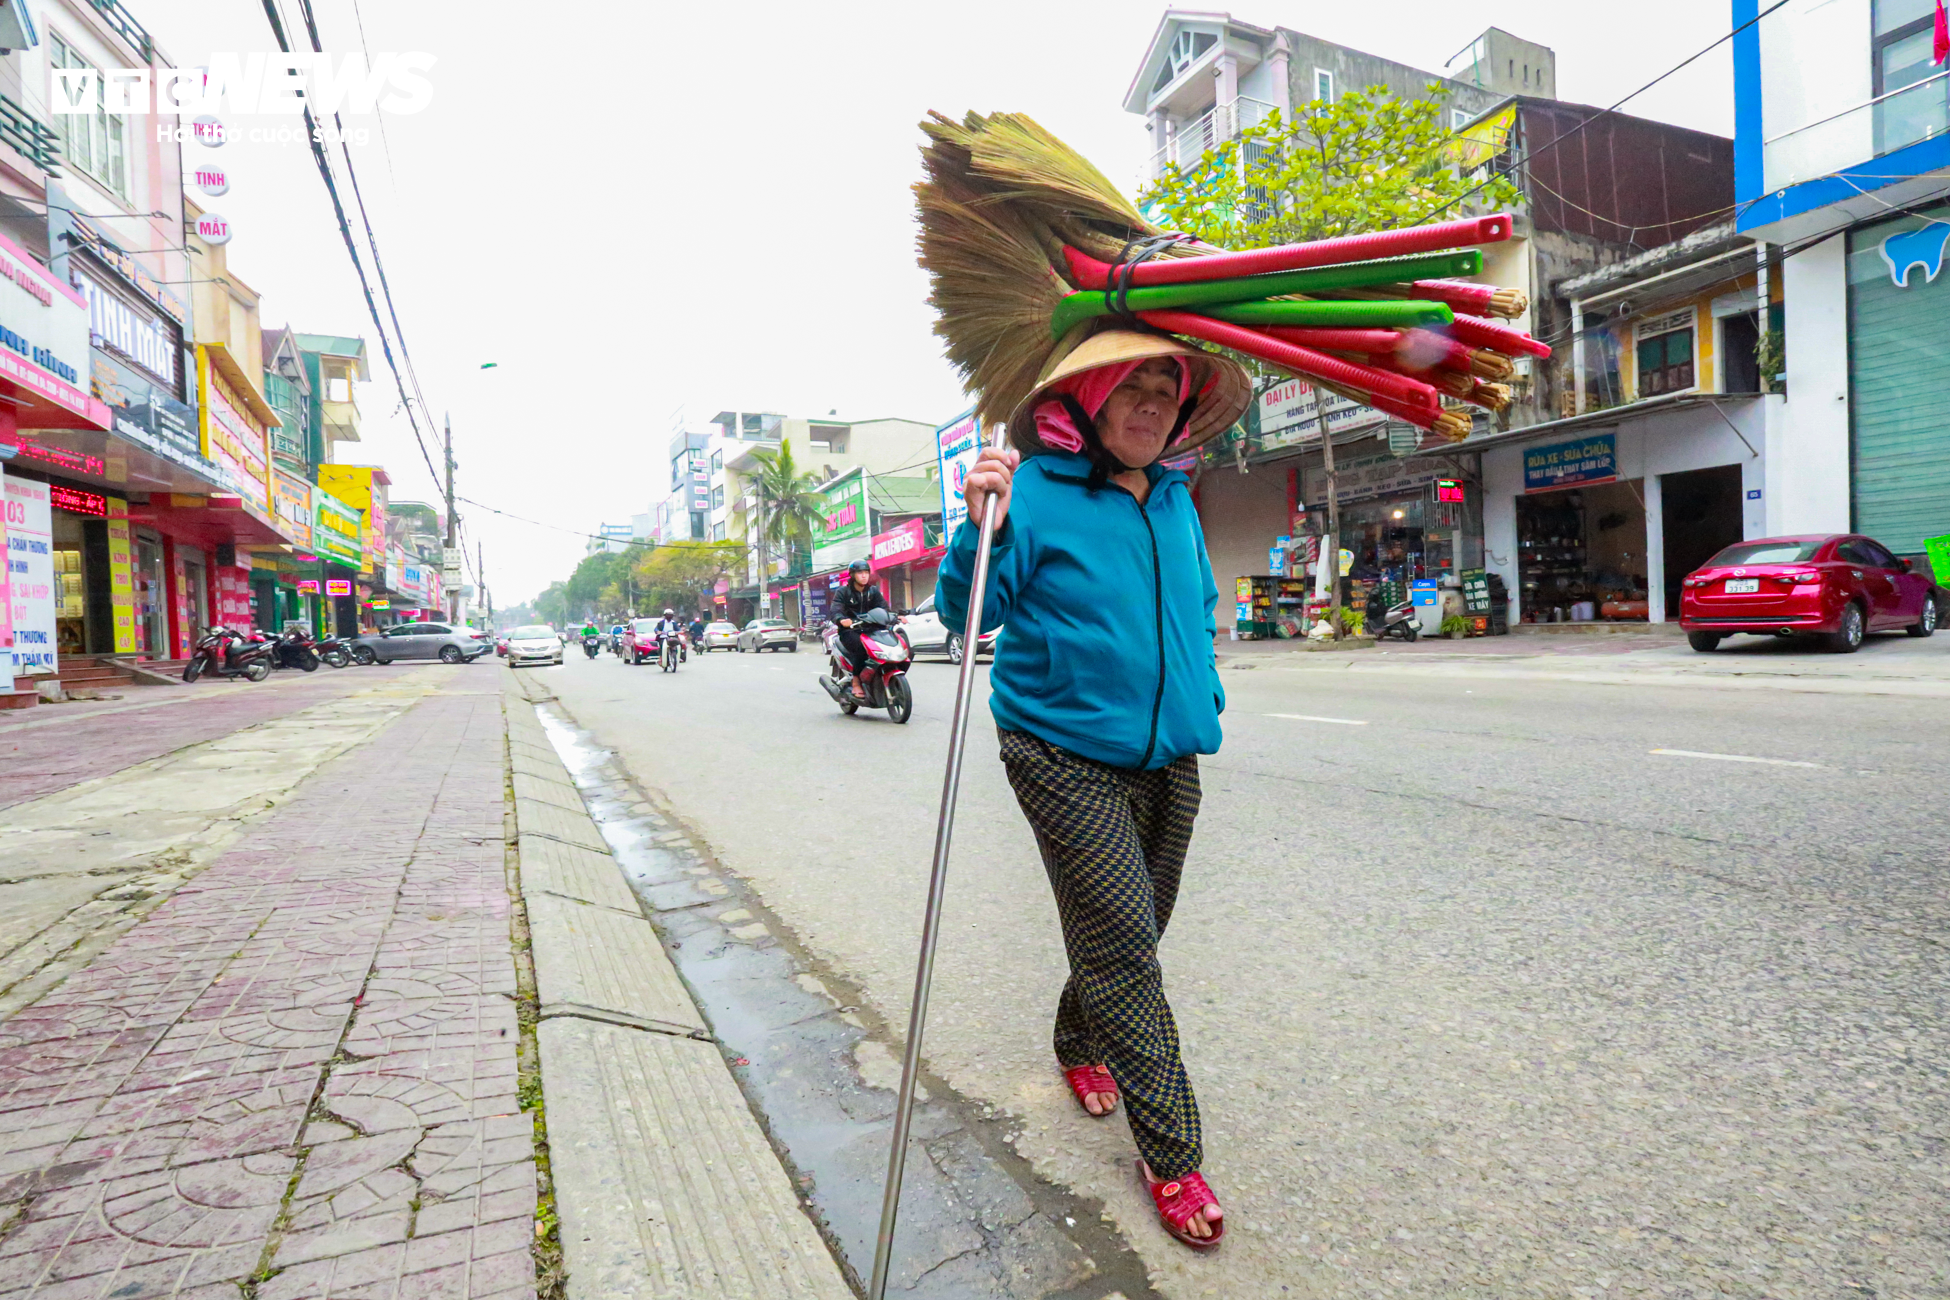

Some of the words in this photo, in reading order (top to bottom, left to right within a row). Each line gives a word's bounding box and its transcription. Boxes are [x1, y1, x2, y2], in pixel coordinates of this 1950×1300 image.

[195, 172, 226, 188] TỊNH
[199, 217, 228, 237] MẮT
[16, 269, 52, 307] NGOẠI
[74, 270, 134, 359] TỊNH
[135, 318, 176, 385] MẮT
[33, 346, 78, 384] HÌNH
[1266, 388, 1283, 407] ĐẠI
[1285, 381, 1296, 400] LÝ
[1286, 405, 1305, 418] HÀNG
[1342, 409, 1357, 421] KẸO
[1528, 452, 1546, 468] RỬA
[1547, 453, 1559, 464] XE
[1564, 445, 1582, 461] SỬA
[1583, 441, 1612, 457] CHỮA
[1529, 468, 1544, 480] THAY
[1564, 463, 1580, 474] THAY
[7, 500, 25, 525] 03
[20, 583, 31, 598] SAI
[1468, 602, 1476, 611] XE
[1476, 599, 1489, 610] MÁY
[118, 616, 130, 627] CAO
[20, 630, 48, 645] THƯƠNG
[120, 634, 131, 648] CẤP
